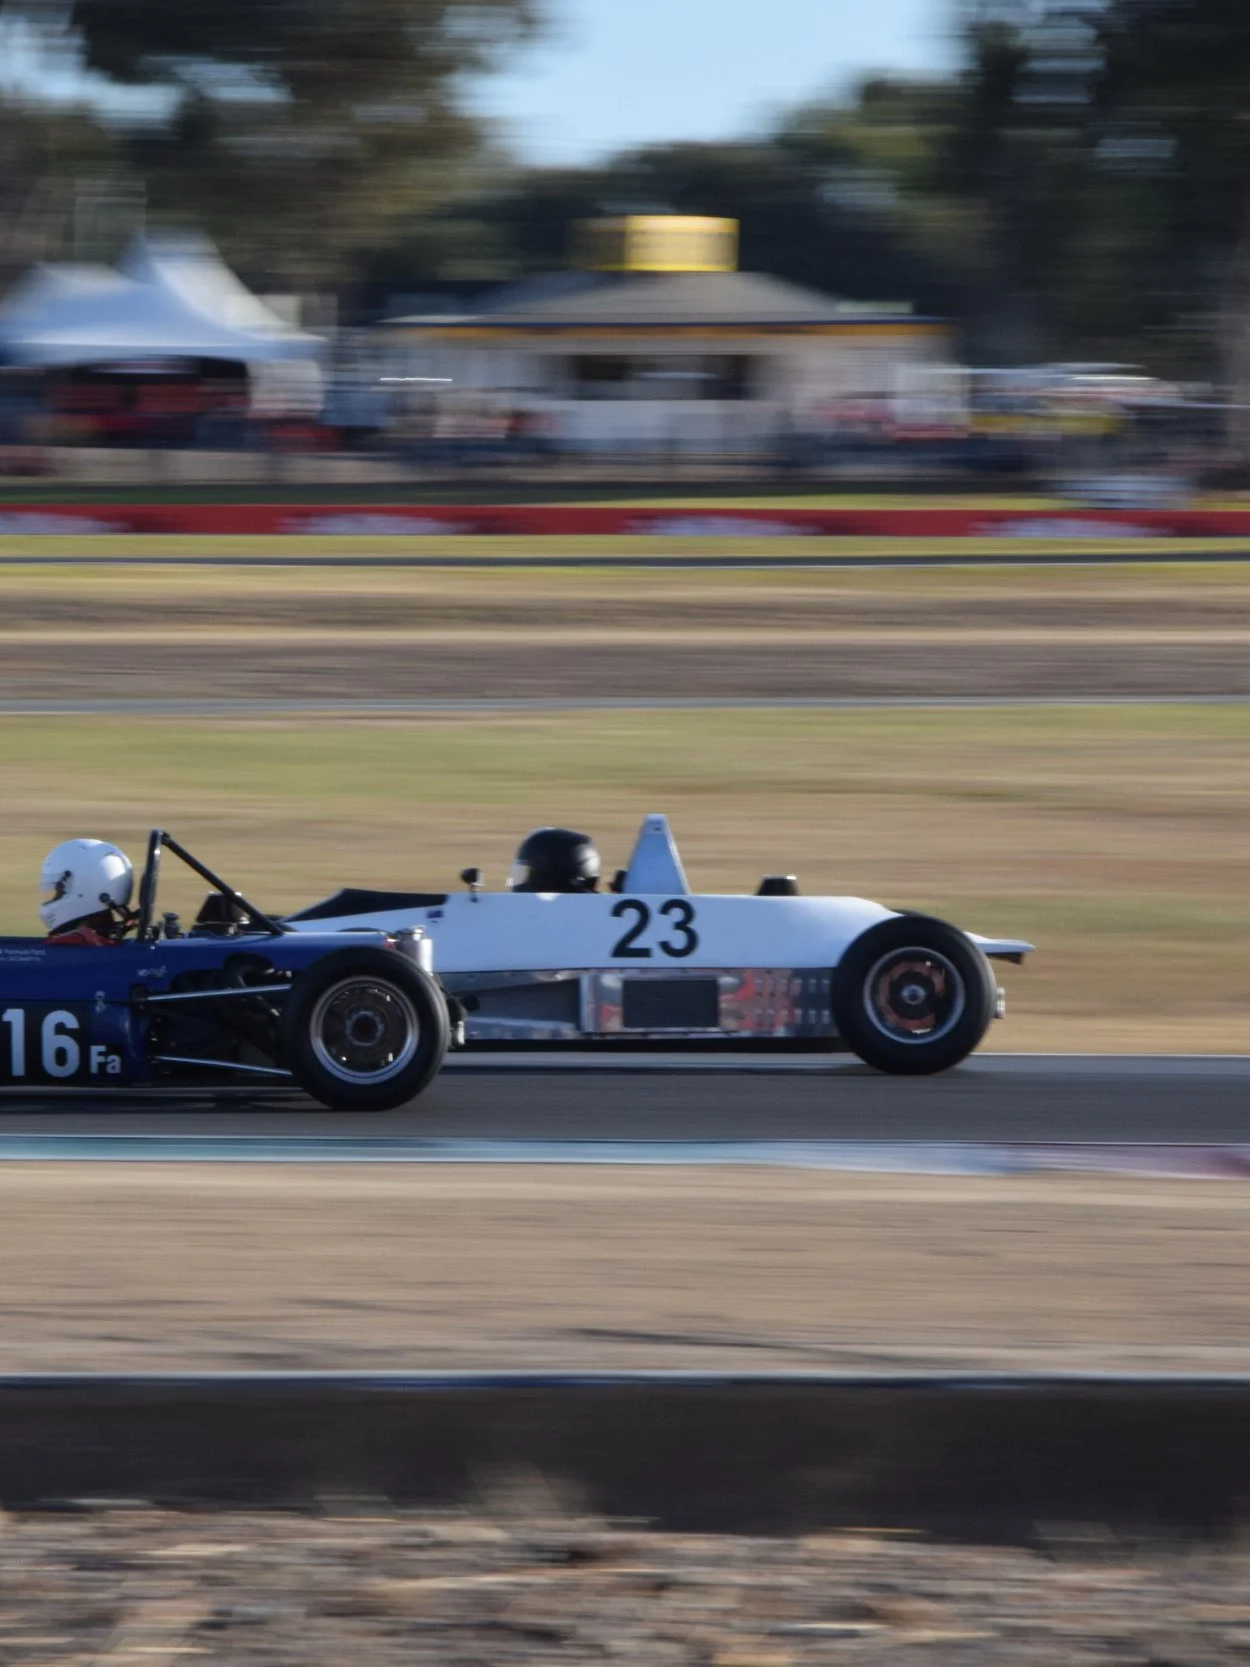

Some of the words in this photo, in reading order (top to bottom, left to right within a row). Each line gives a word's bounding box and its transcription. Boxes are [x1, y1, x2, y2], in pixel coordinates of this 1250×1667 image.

[610, 898, 700, 959] 23
[1, 1007, 81, 1078] 16
[89, 1044, 123, 1075] Fa
